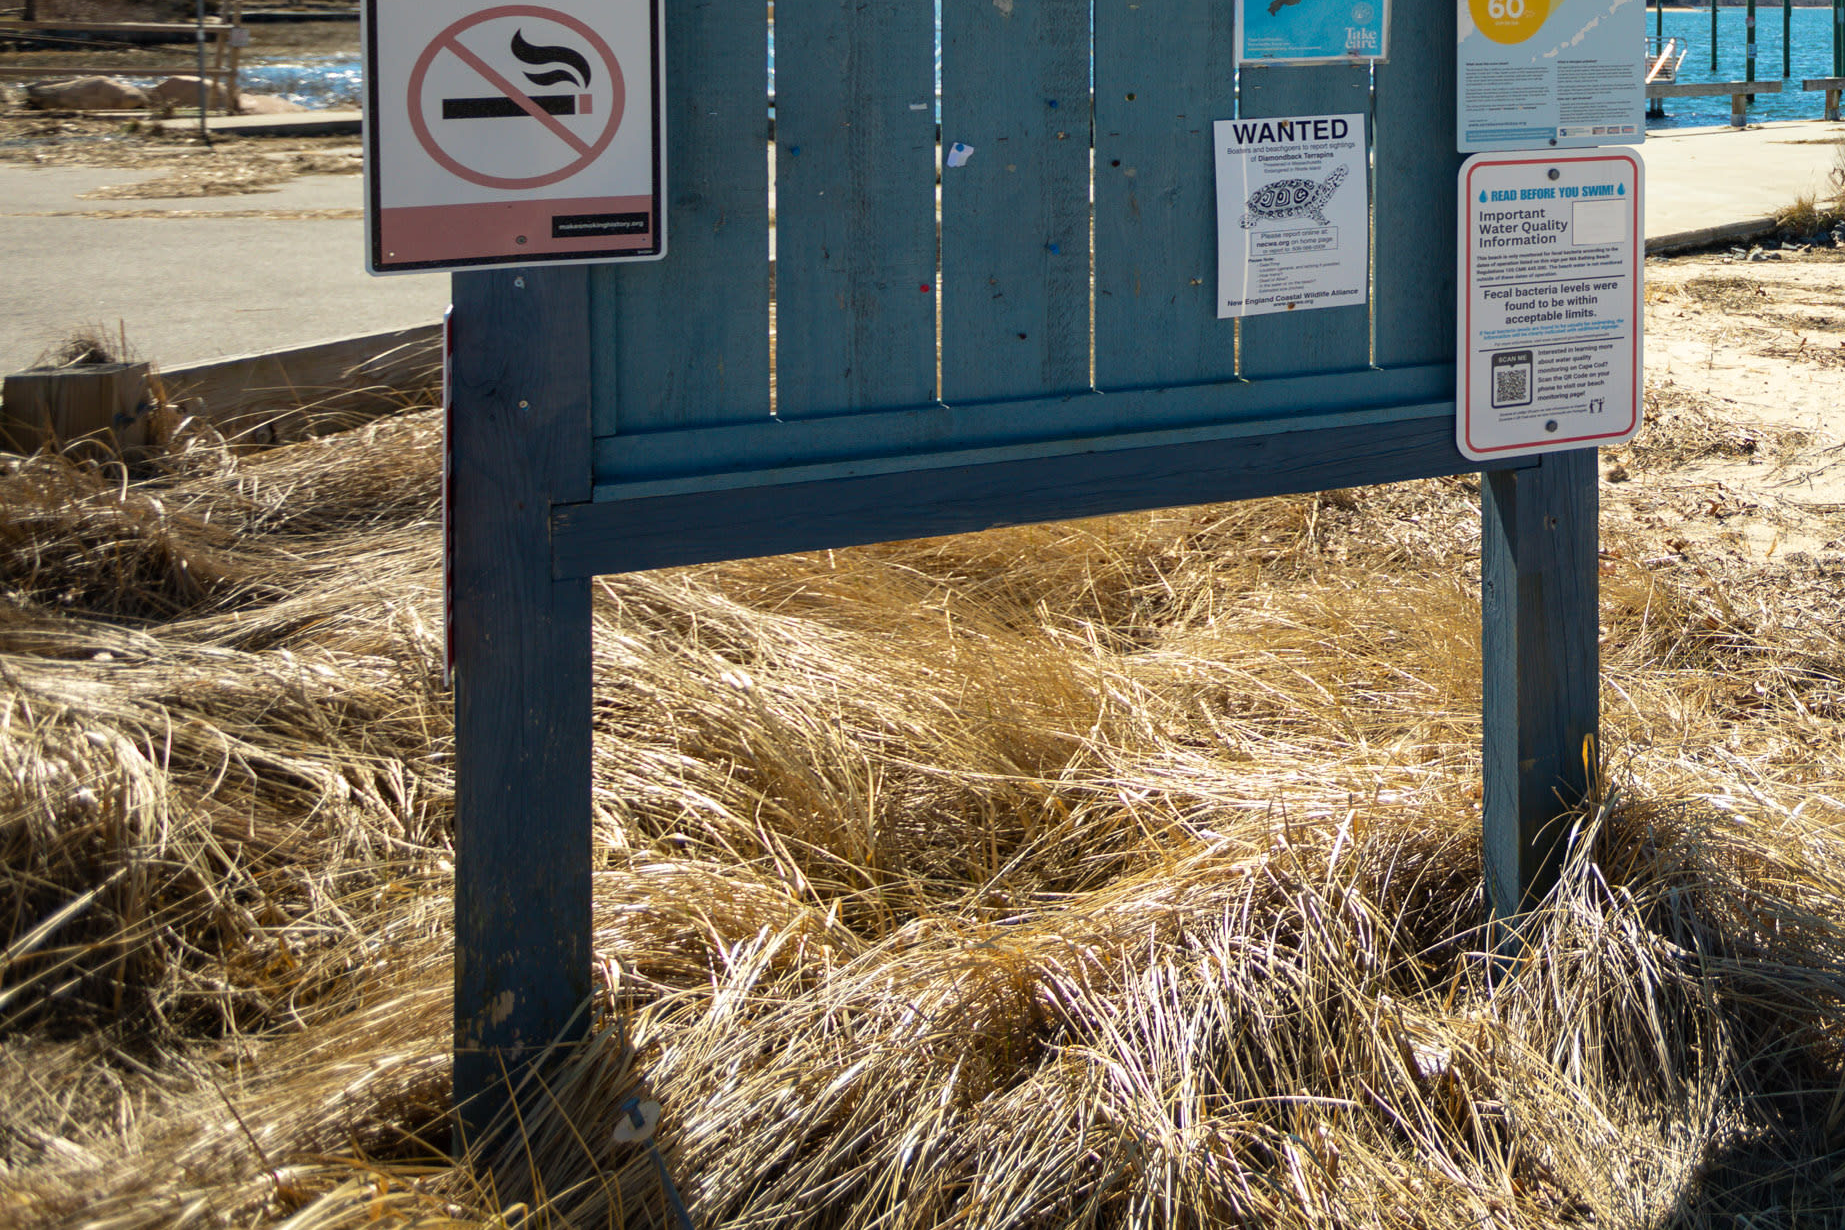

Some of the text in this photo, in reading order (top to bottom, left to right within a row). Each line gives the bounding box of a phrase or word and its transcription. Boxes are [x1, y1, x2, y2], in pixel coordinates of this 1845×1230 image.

[1233, 119, 1348, 144] WANTED
[1227, 146, 1251, 154] Boaters
[1265, 144, 1301, 153] beachgoers
[1310, 143, 1328, 151] report
[1258, 153, 1302, 161] Diamondback
[1491, 184, 1614, 202] READ BEFORE YOU SWIM!
[1480, 208, 1546, 223] Important
[1479, 220, 1568, 235] Water Quality
[1479, 234, 1557, 248] Information
[1484, 281, 1618, 299] Fecal bacteria levels were
[1245, 296, 1274, 305] England
[1275, 294, 1302, 302] Coastal
[1304, 291, 1329, 299] Wildlife
[1505, 295, 1598, 311] found to be within
[1505, 308, 1597, 325] acceptable limits.
[1538, 347, 1567, 356] Interested
[1574, 345, 1597, 354] learning
[1498, 355, 1517, 363] SCAN
[1538, 357, 1554, 365] about
[1572, 354, 1591, 362] quality
[1538, 365, 1569, 374] monitoring
[1578, 363, 1593, 371] Cape
[1573, 372, 1588, 380] Code
[1538, 384, 1555, 393] phone
[1538, 392, 1569, 402] monitoring
